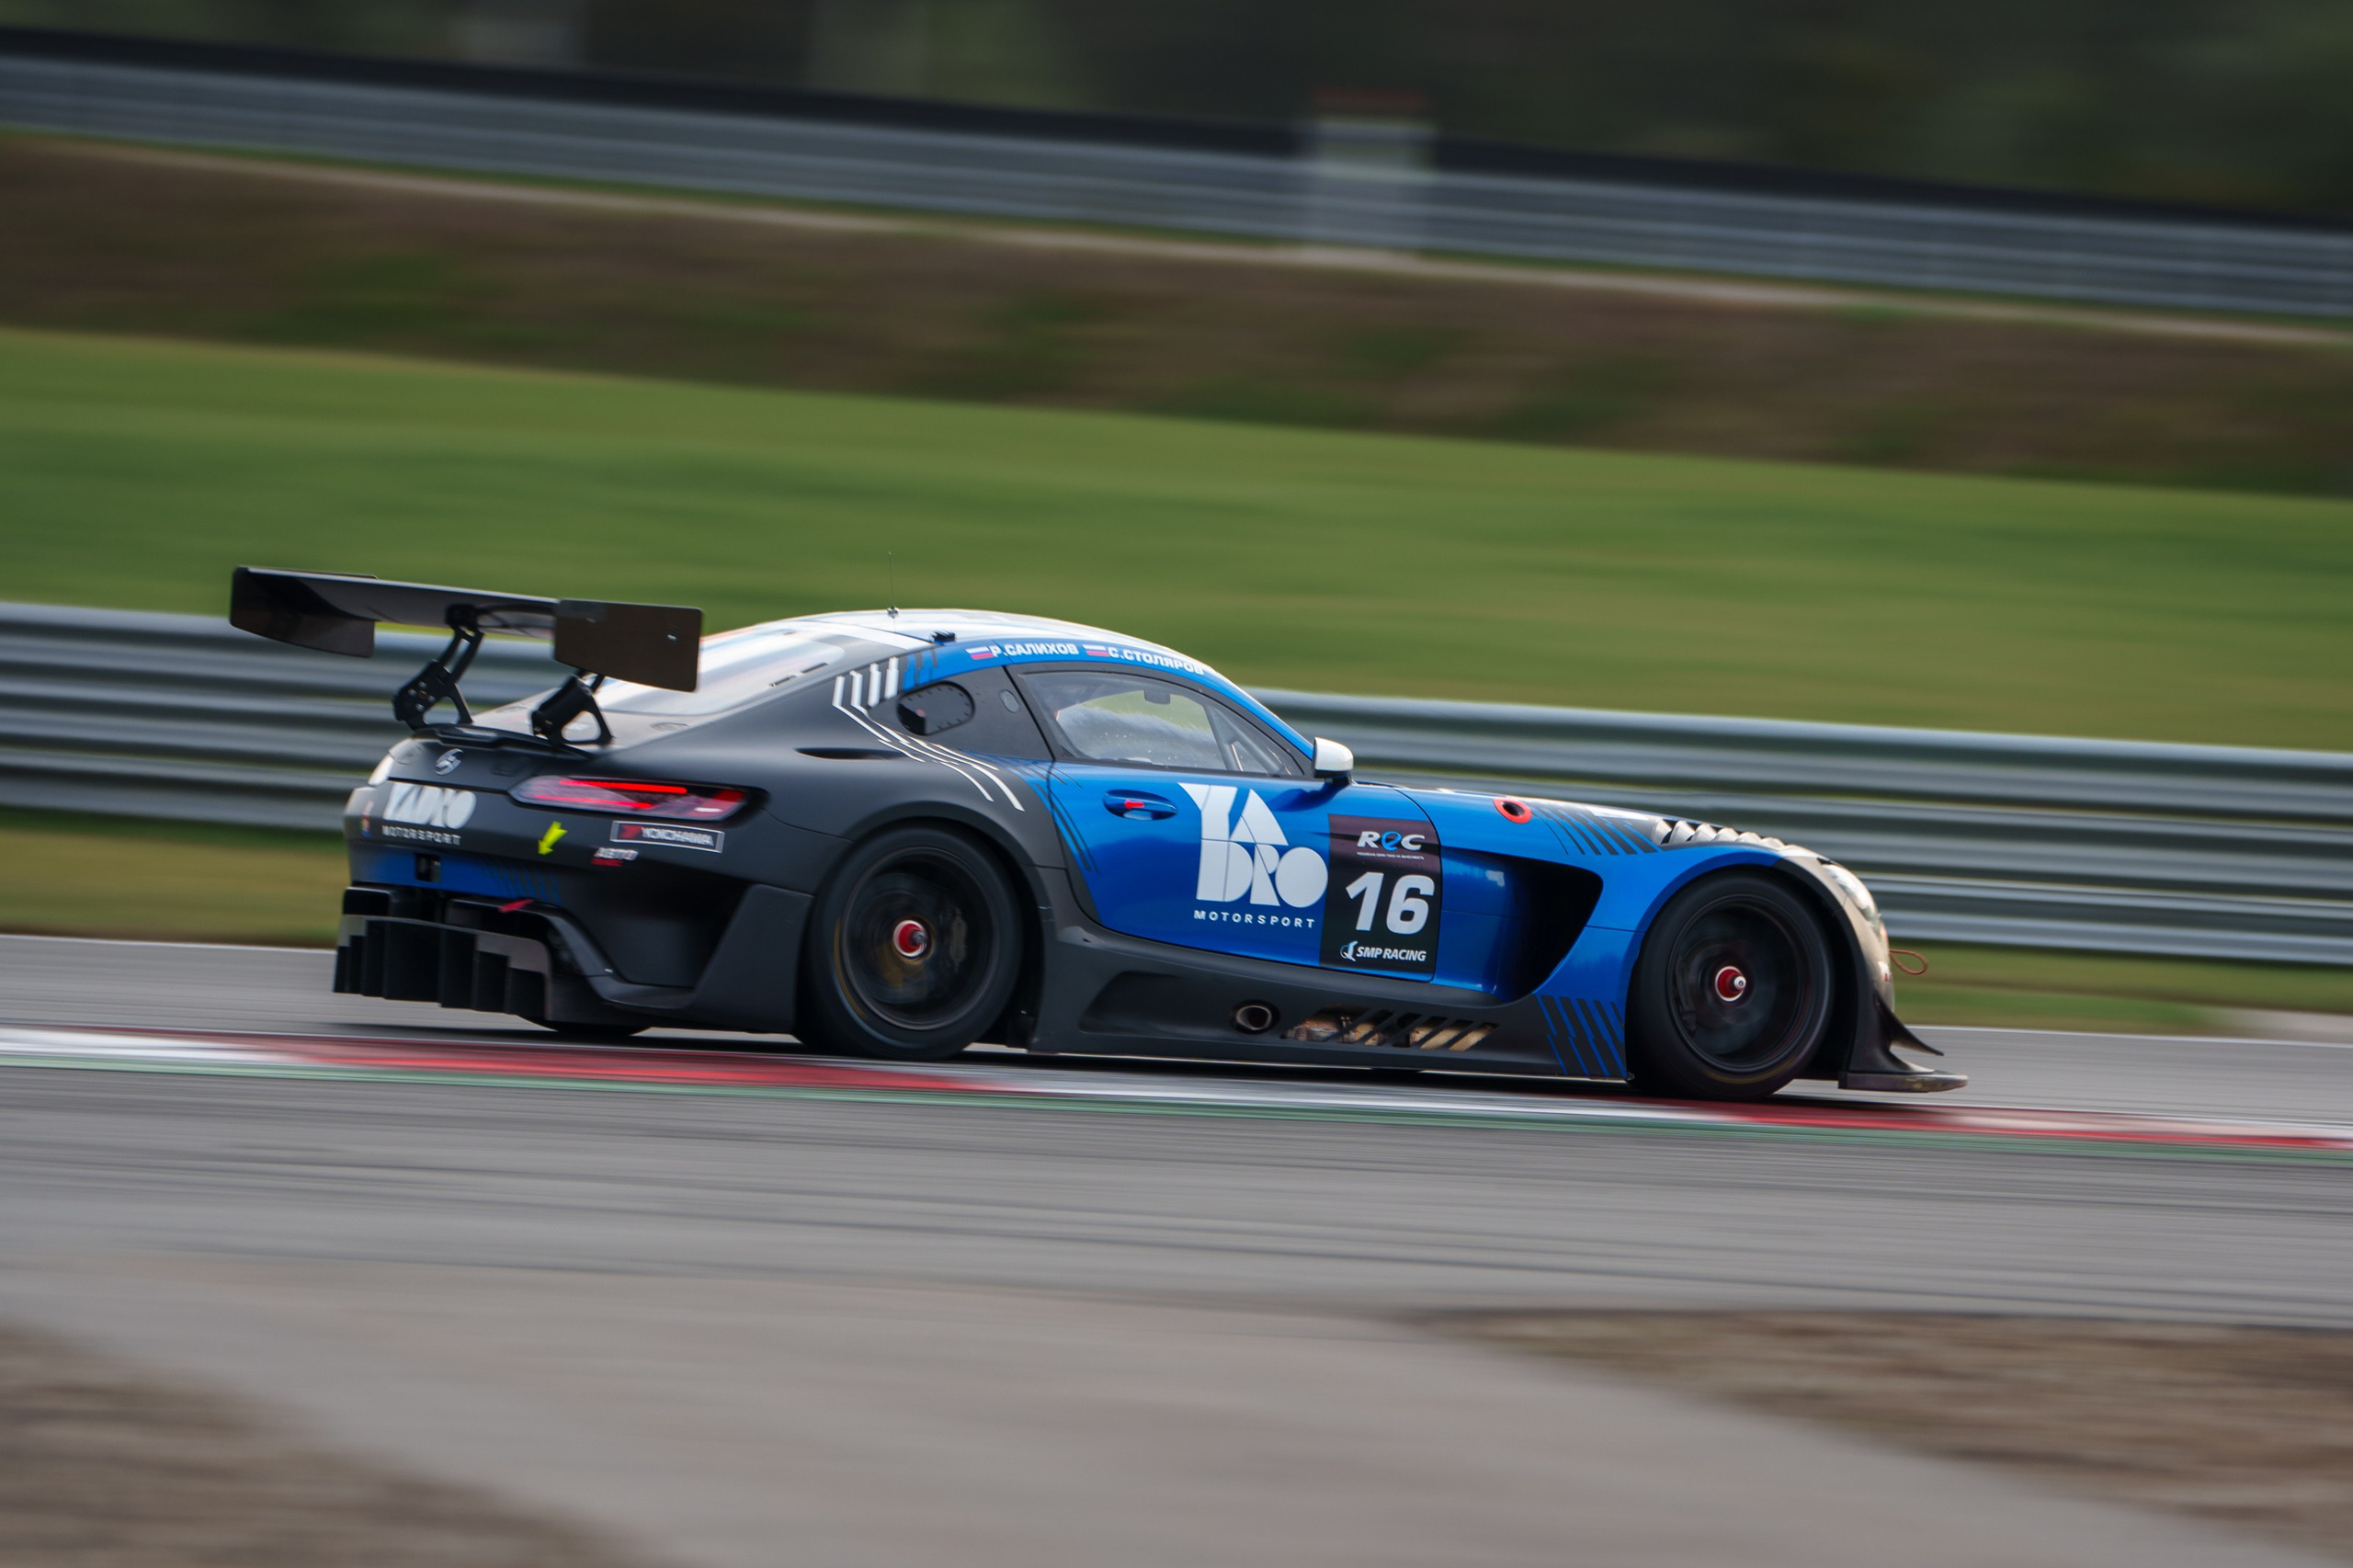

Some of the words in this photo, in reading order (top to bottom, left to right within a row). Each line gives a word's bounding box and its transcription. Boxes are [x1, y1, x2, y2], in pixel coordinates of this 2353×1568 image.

[1346, 871, 1436, 936] 16
[1194, 909, 1315, 929] MOTORSPORT
[1357, 946, 1382, 960] SMP
[1382, 948, 1427, 962] RACING
